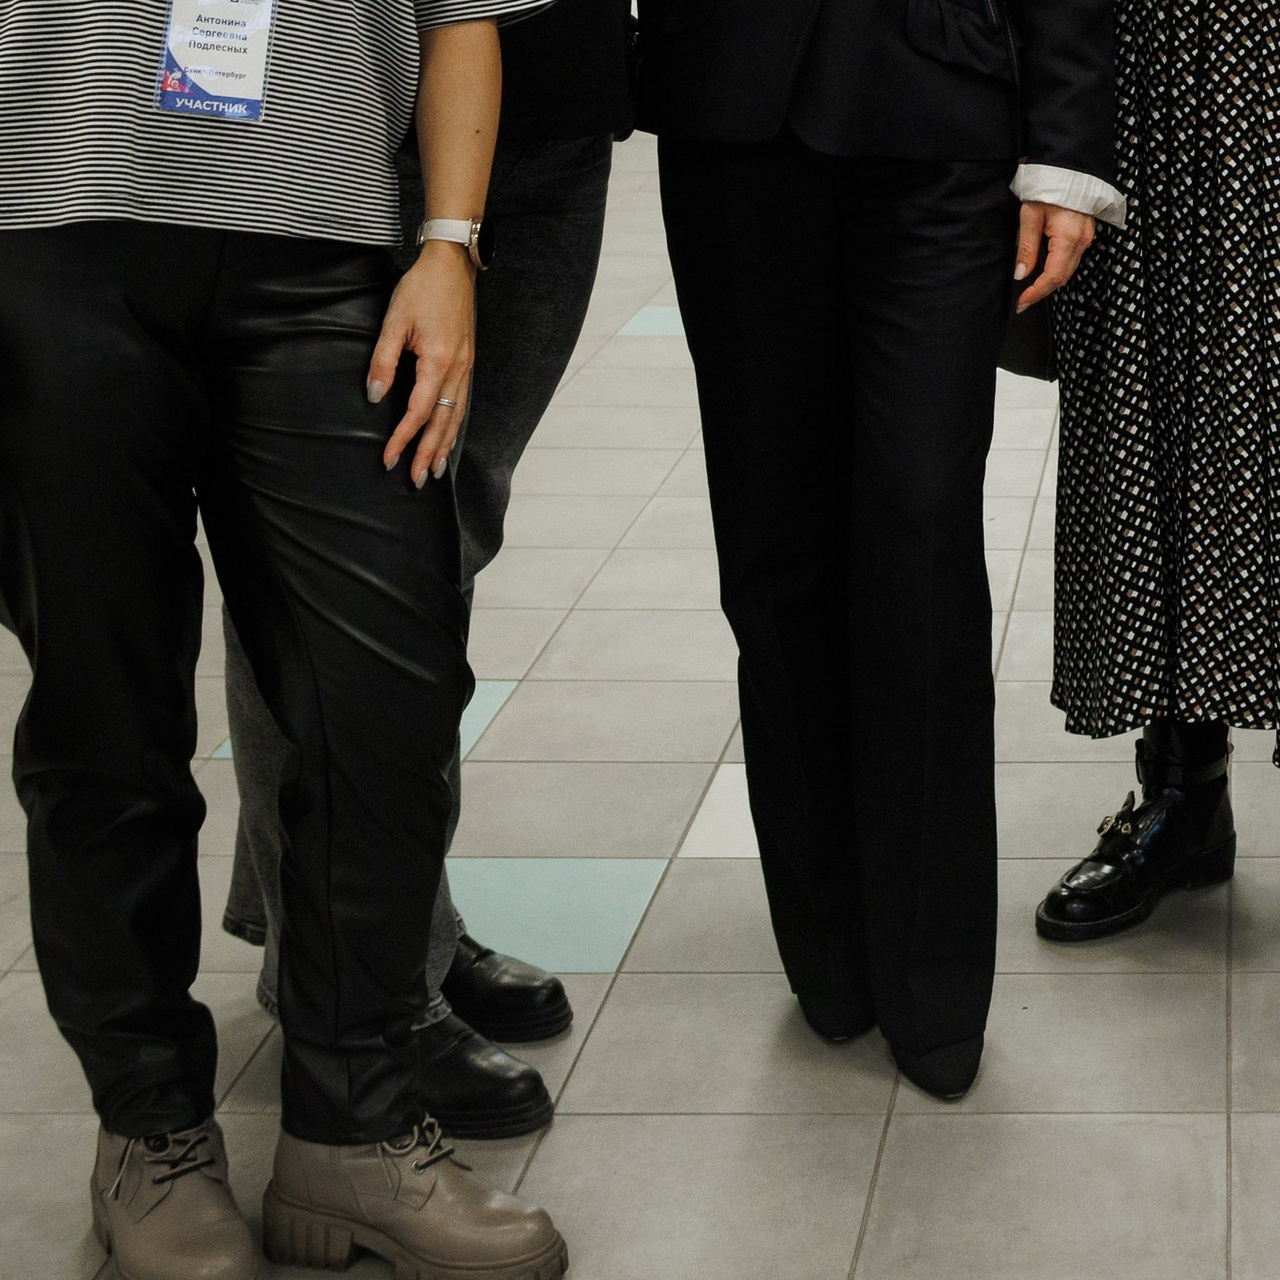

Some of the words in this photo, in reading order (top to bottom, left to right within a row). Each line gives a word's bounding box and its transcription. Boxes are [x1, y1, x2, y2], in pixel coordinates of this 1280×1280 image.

[195, 14, 247, 28] Антонина
[192, 26, 248, 42] Сергеевна
[188, 40, 249, 55] Подлесных
[175, 97, 248, 115] УЧАСТНИК
